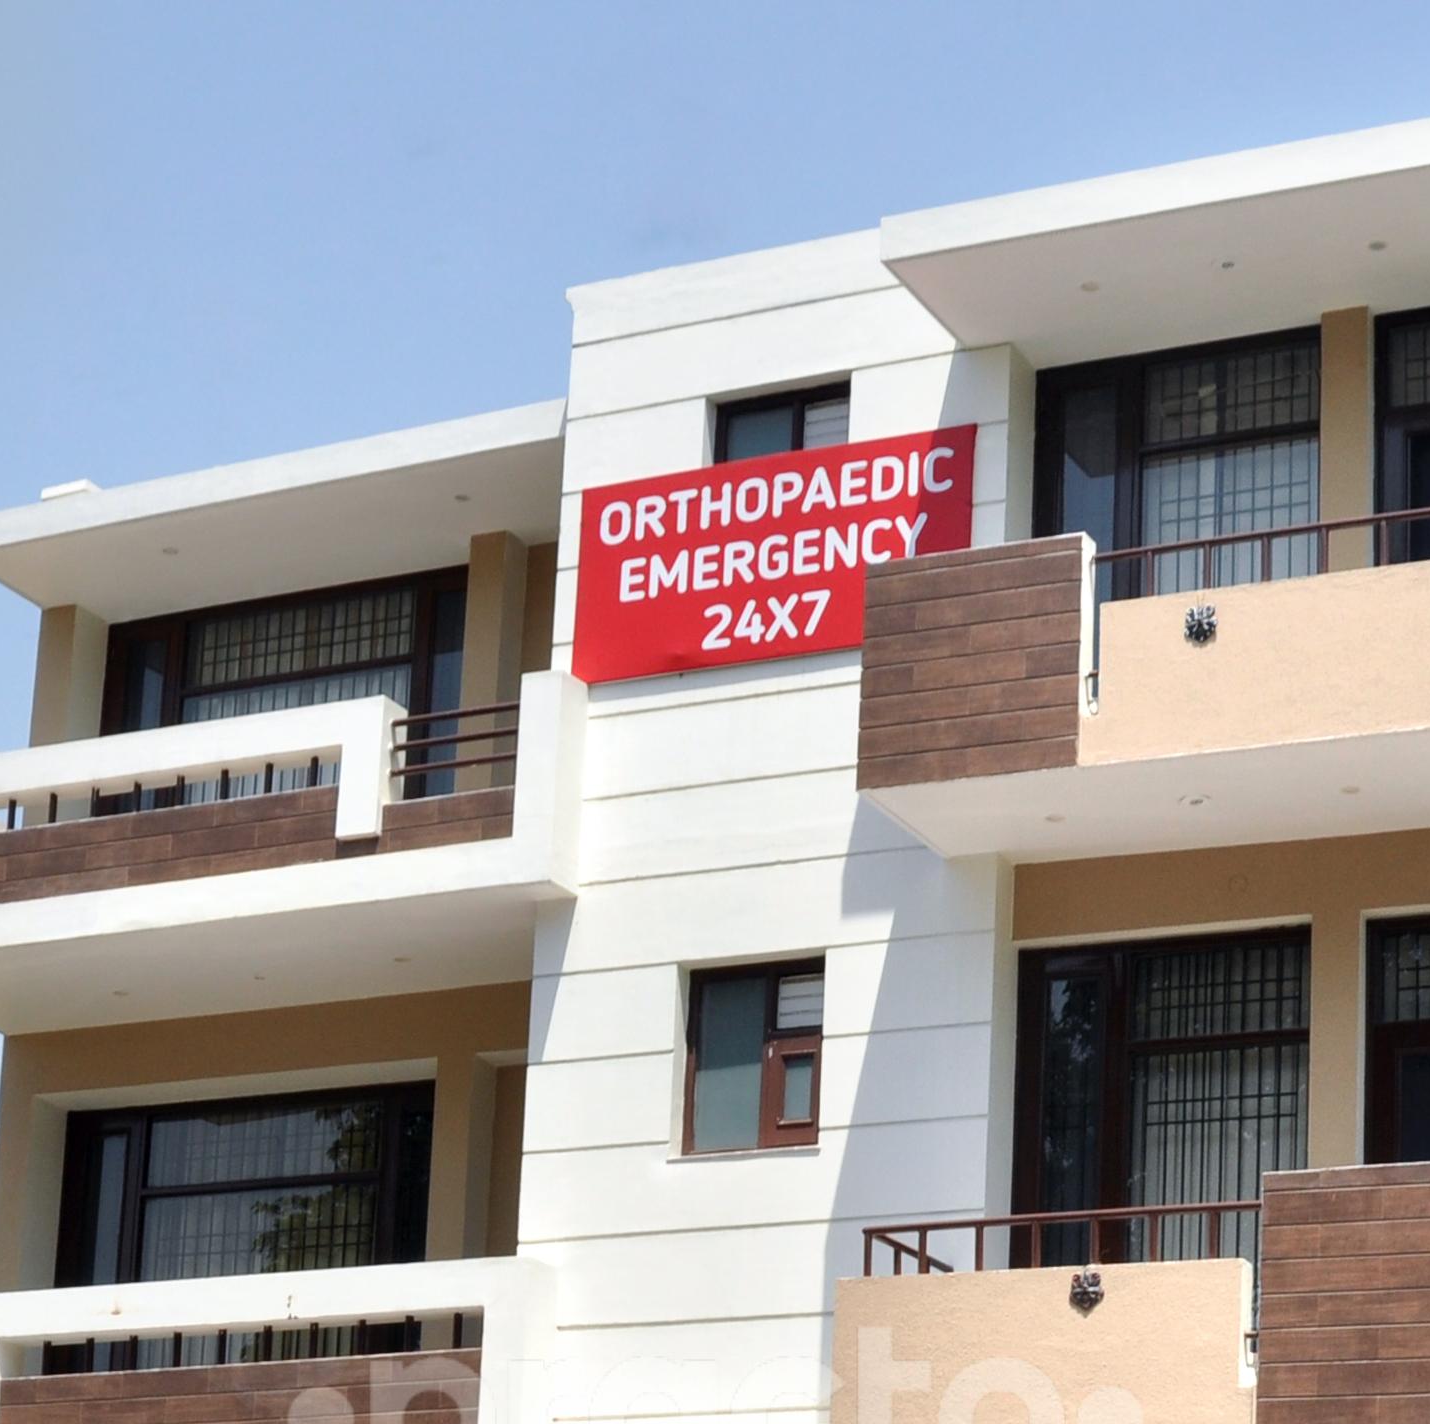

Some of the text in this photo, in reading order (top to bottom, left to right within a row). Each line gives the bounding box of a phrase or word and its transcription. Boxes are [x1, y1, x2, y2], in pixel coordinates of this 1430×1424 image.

[599, 447, 954, 545] ORTHOPAEDIC
[619, 512, 928, 603] EMERGENCY
[701, 589, 831, 651] 24X7
